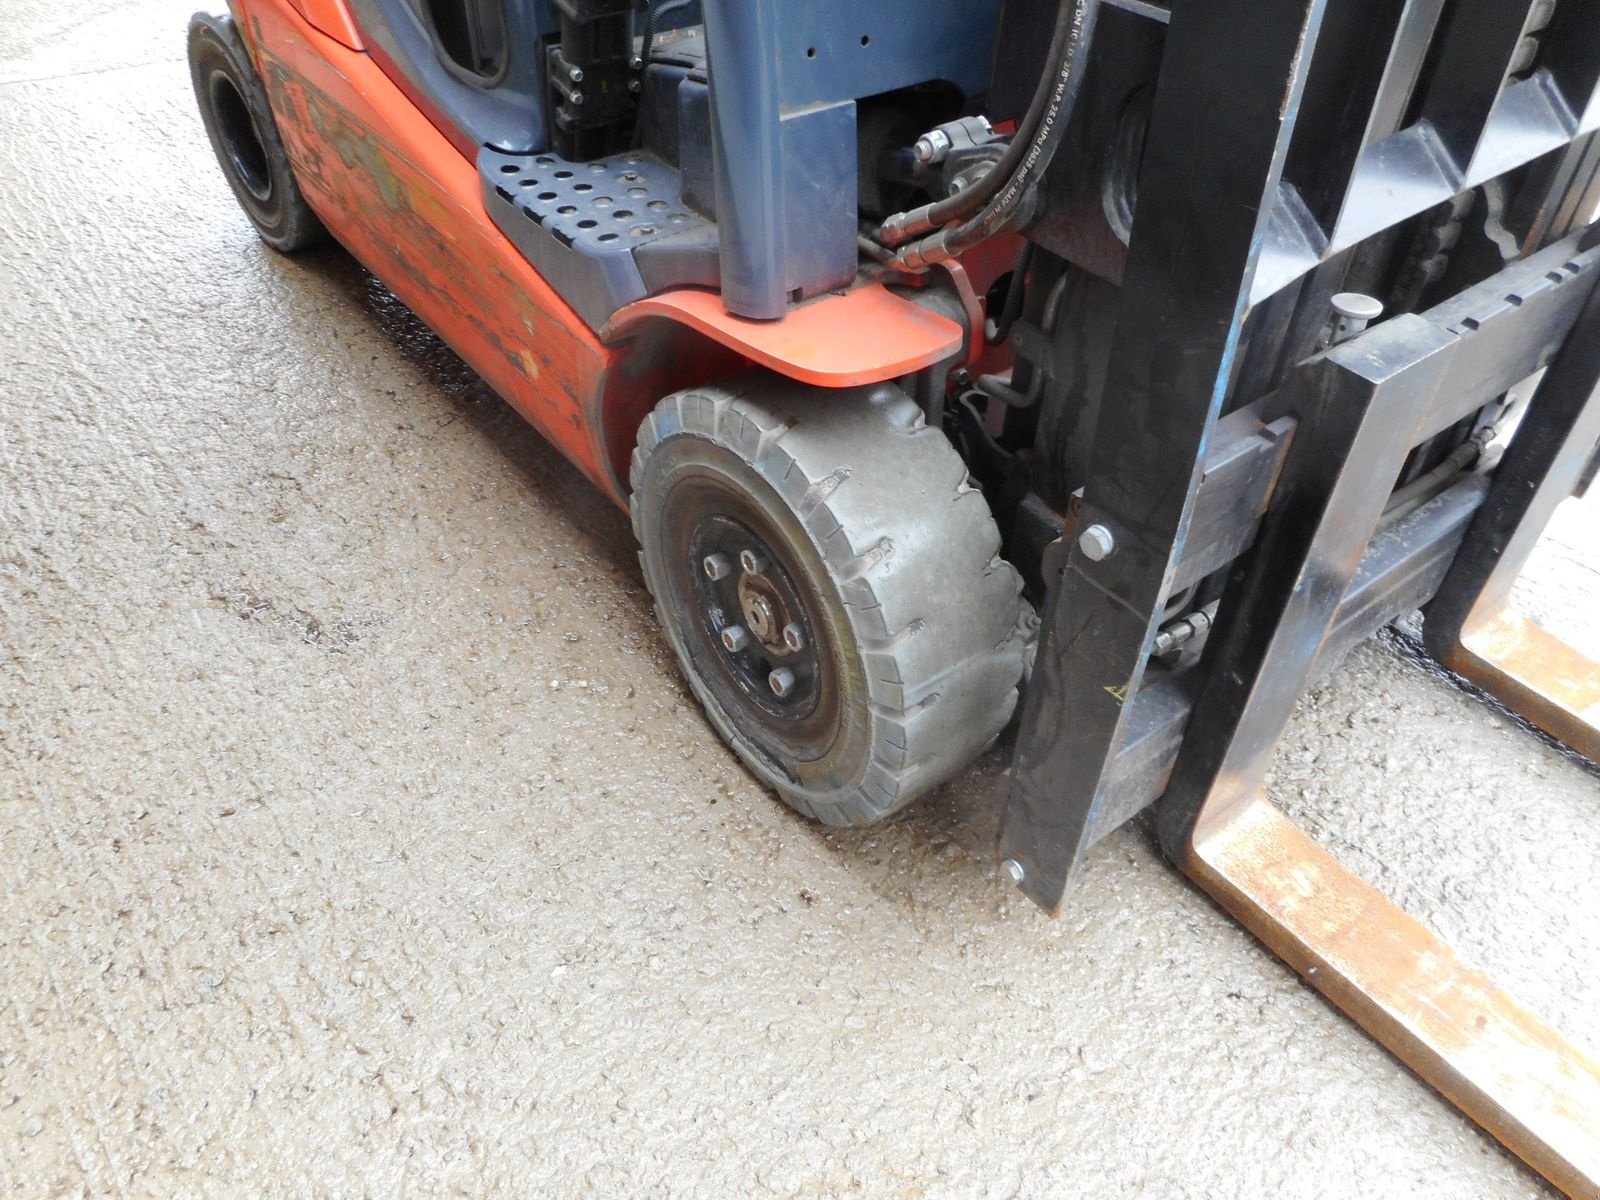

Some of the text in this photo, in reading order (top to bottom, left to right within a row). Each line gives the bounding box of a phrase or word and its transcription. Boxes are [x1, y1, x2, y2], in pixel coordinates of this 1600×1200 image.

[1073, 9, 1082, 26] DN
[1047, 104, 1058, 124] 25.0
[1037, 125, 1050, 145] MPa
[1026, 145, 1041, 169] (3625
